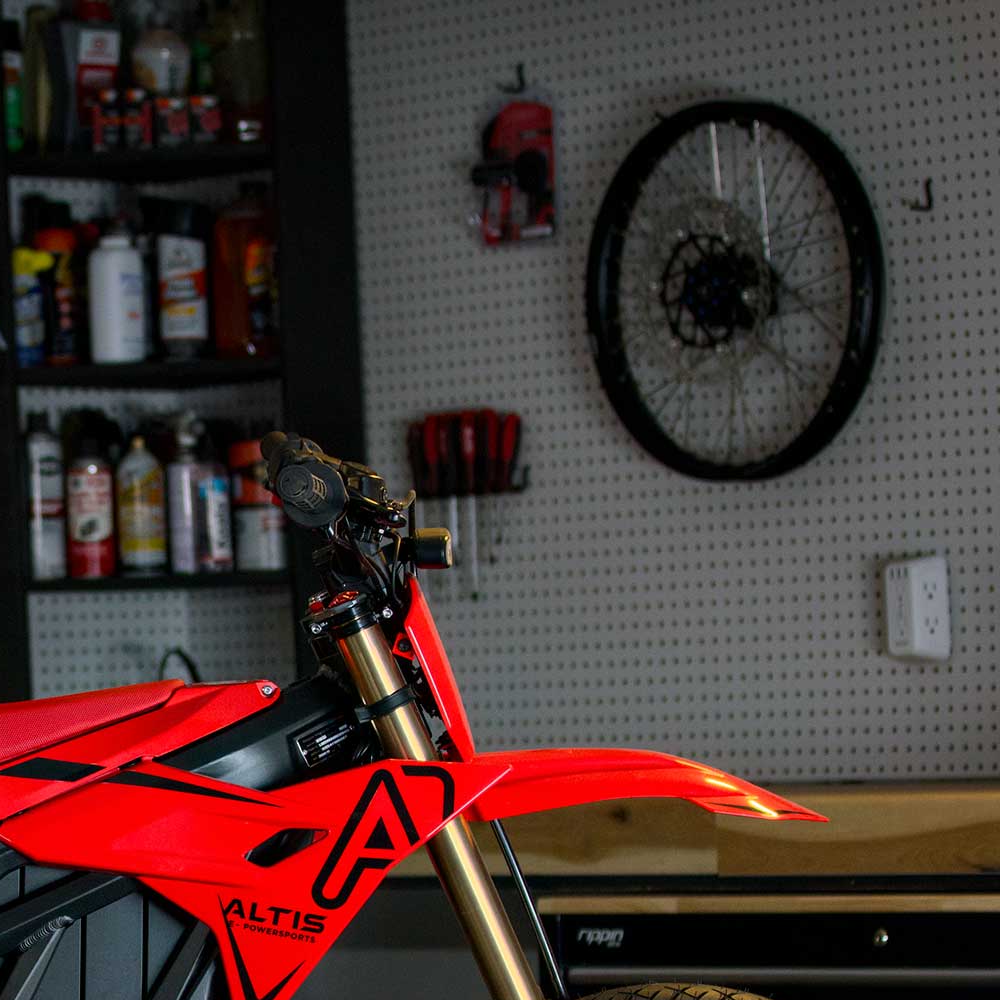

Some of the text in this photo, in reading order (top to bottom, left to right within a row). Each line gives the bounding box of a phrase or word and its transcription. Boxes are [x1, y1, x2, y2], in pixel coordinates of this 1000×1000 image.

[223, 898, 328, 934] ALTIS
[243, 923, 316, 943] POWERSPORTS
[576, 926, 624, 947] rippin
